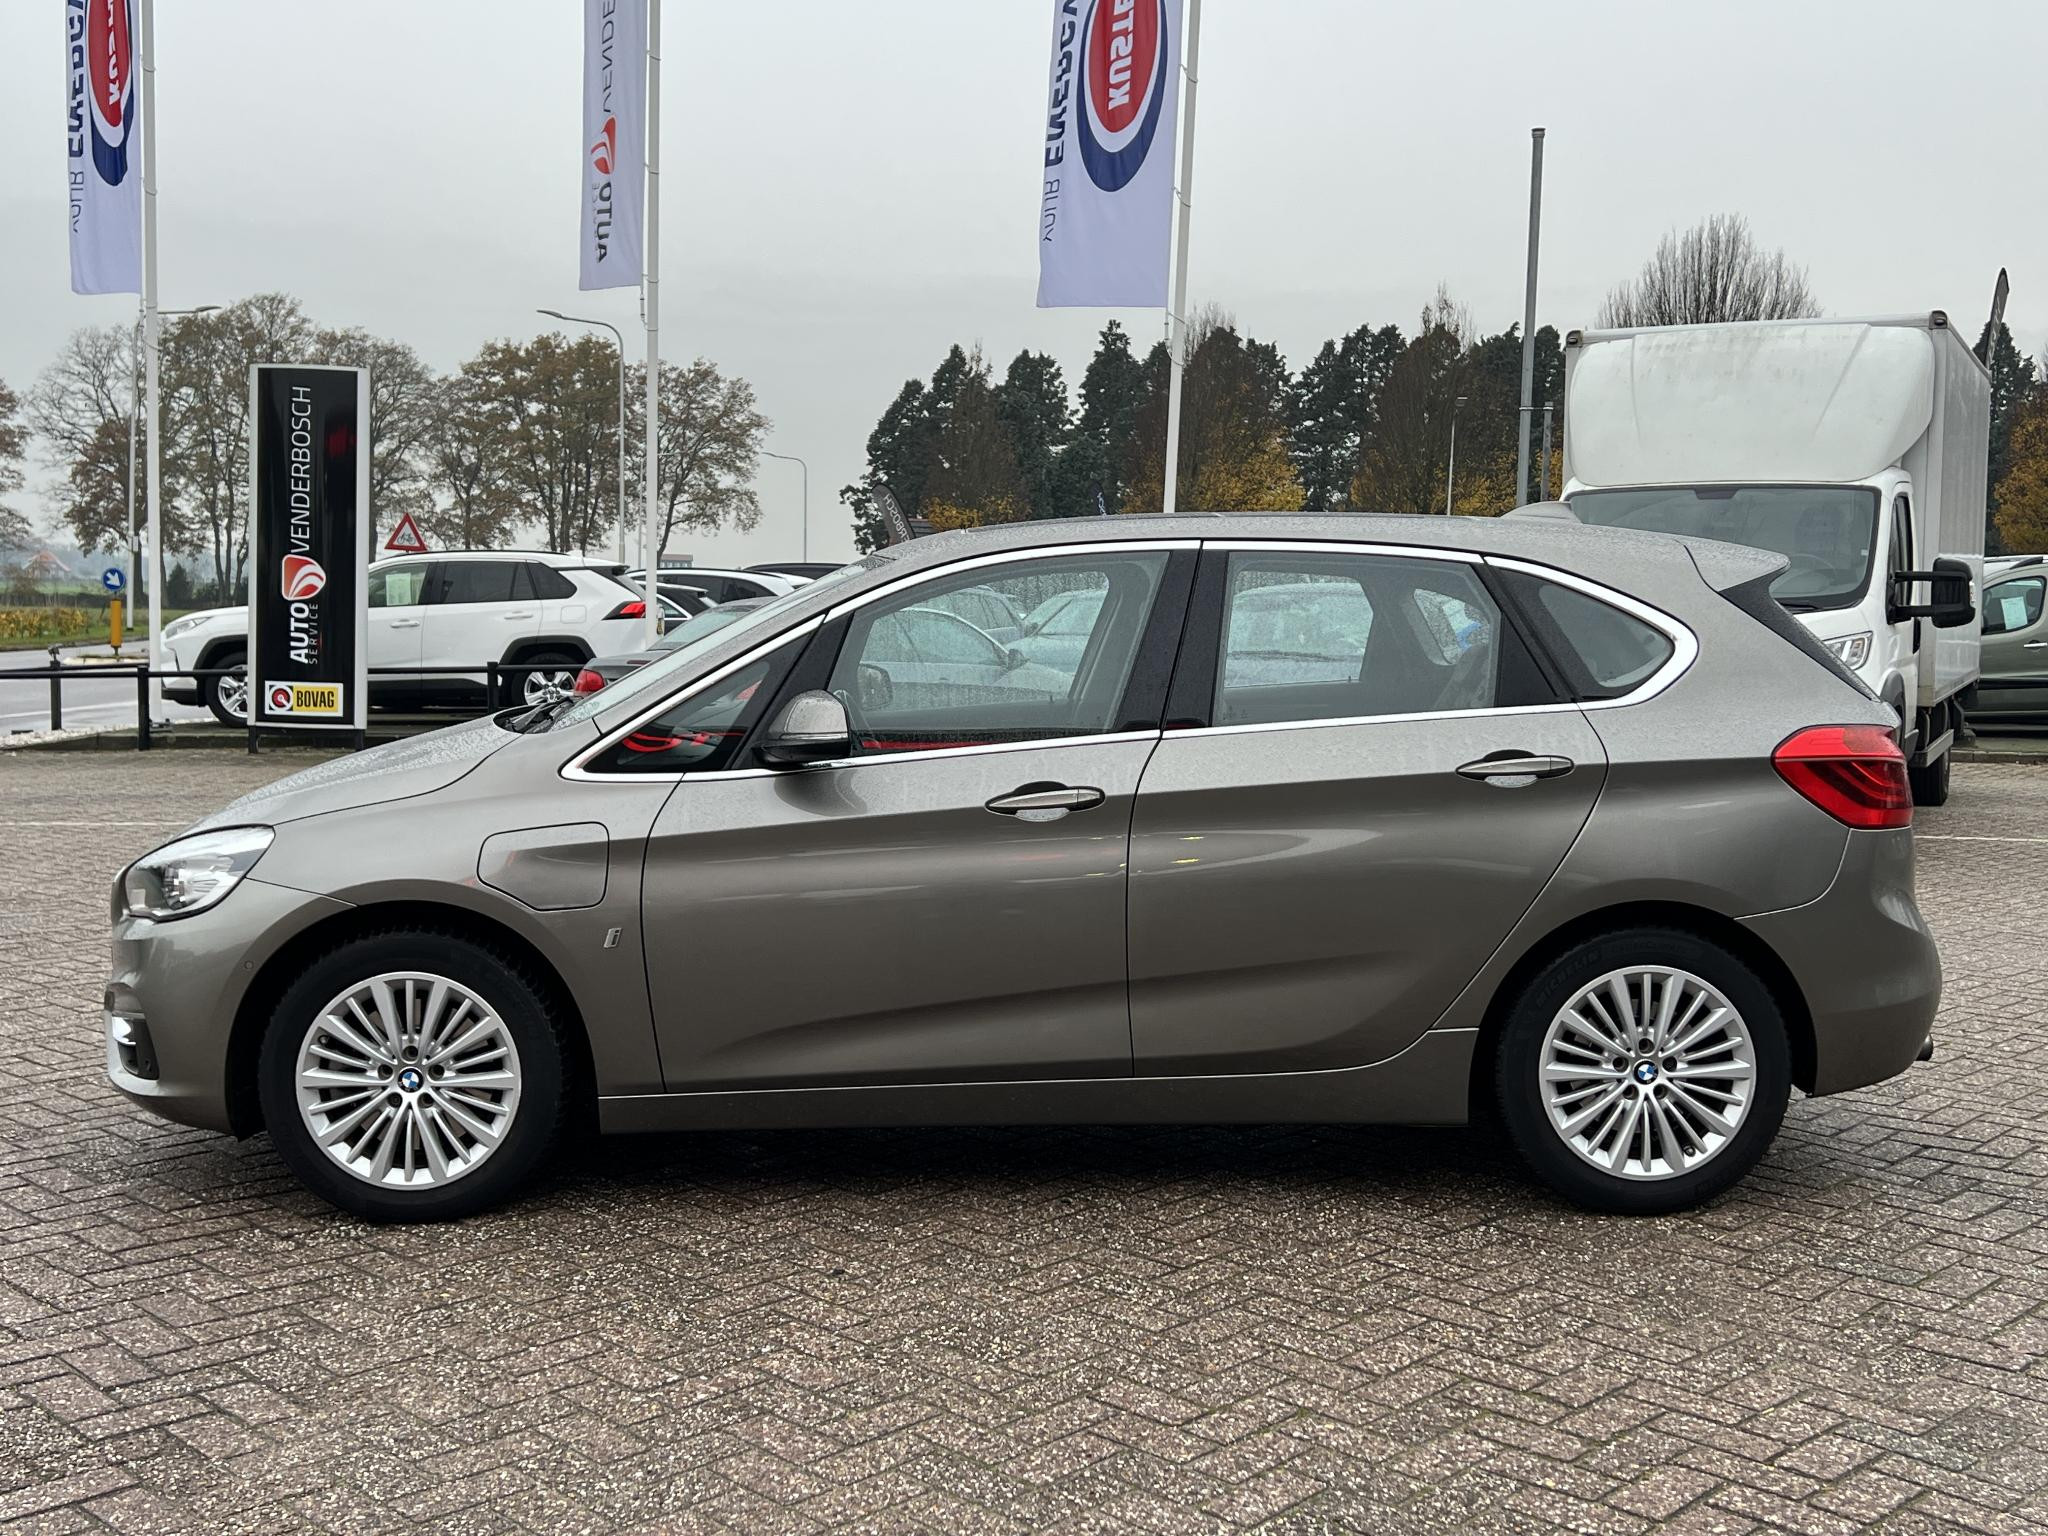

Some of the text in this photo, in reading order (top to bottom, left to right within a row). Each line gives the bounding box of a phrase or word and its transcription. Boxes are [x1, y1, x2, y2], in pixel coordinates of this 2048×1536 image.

[290, 386, 311, 664] AUTO VENDERBOSCH
[309, 603, 318, 664] SERVICE
[296, 690, 334, 708] BOVAG
